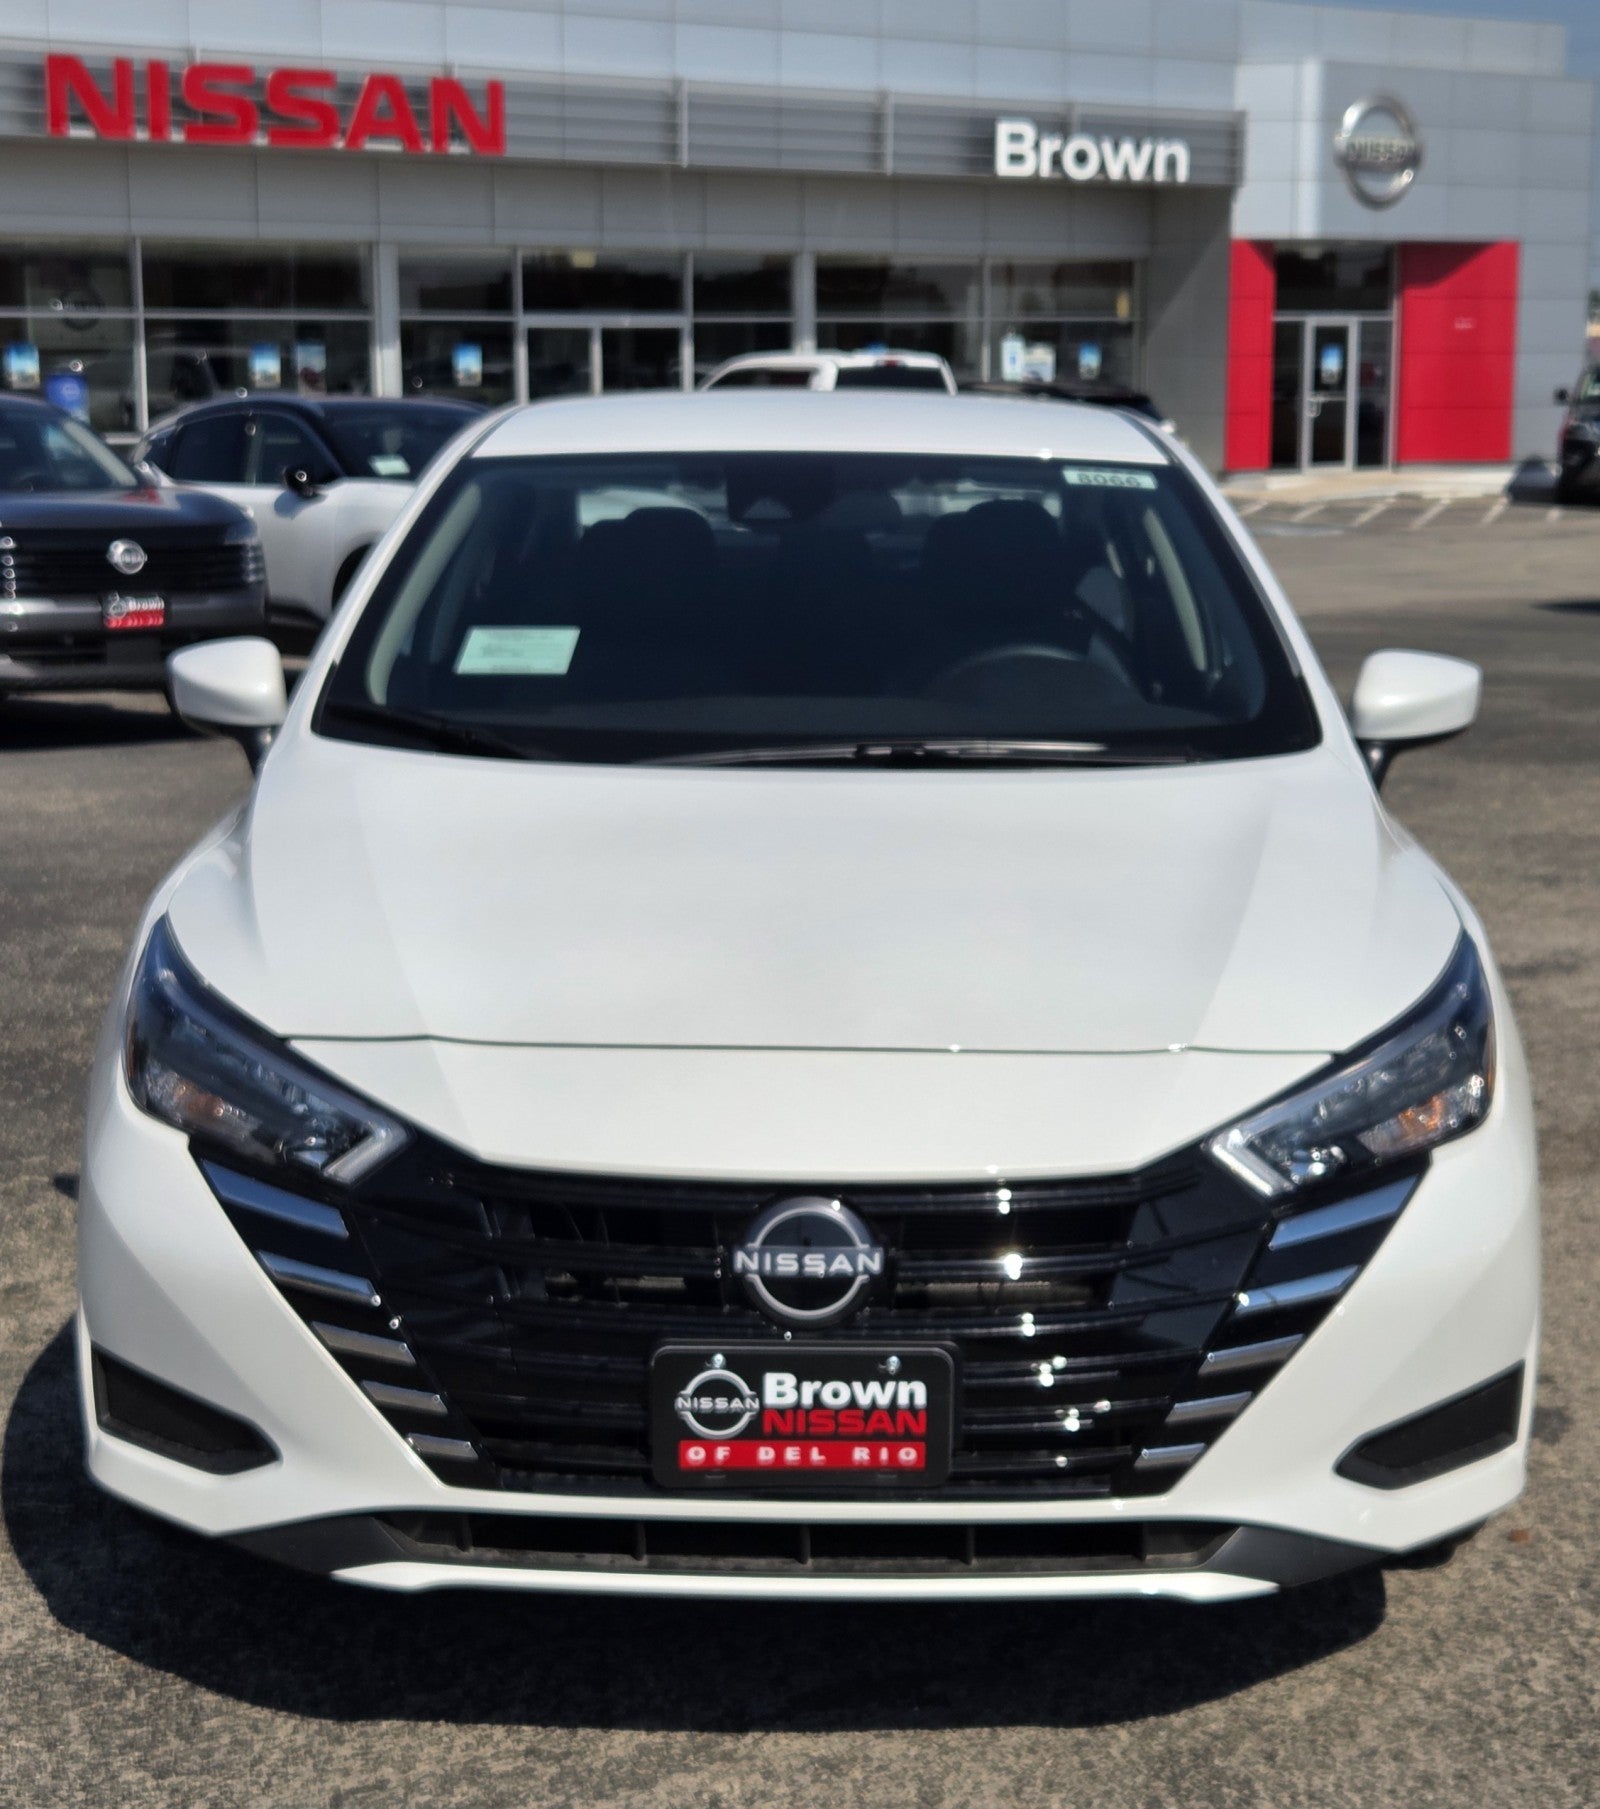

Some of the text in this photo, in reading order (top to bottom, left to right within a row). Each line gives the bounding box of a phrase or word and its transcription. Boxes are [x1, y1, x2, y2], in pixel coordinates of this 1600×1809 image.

[44, 54, 506, 156] NISSAN
[995, 120, 1190, 184] Brown
[733, 1250, 884, 1277] NISSAN
[763, 1372, 928, 1409] Brown
[676, 1396, 760, 1414] NISSAN
[763, 1409, 928, 1435] NISSAN
[686, 1446, 919, 1465] OF DEL RIO
